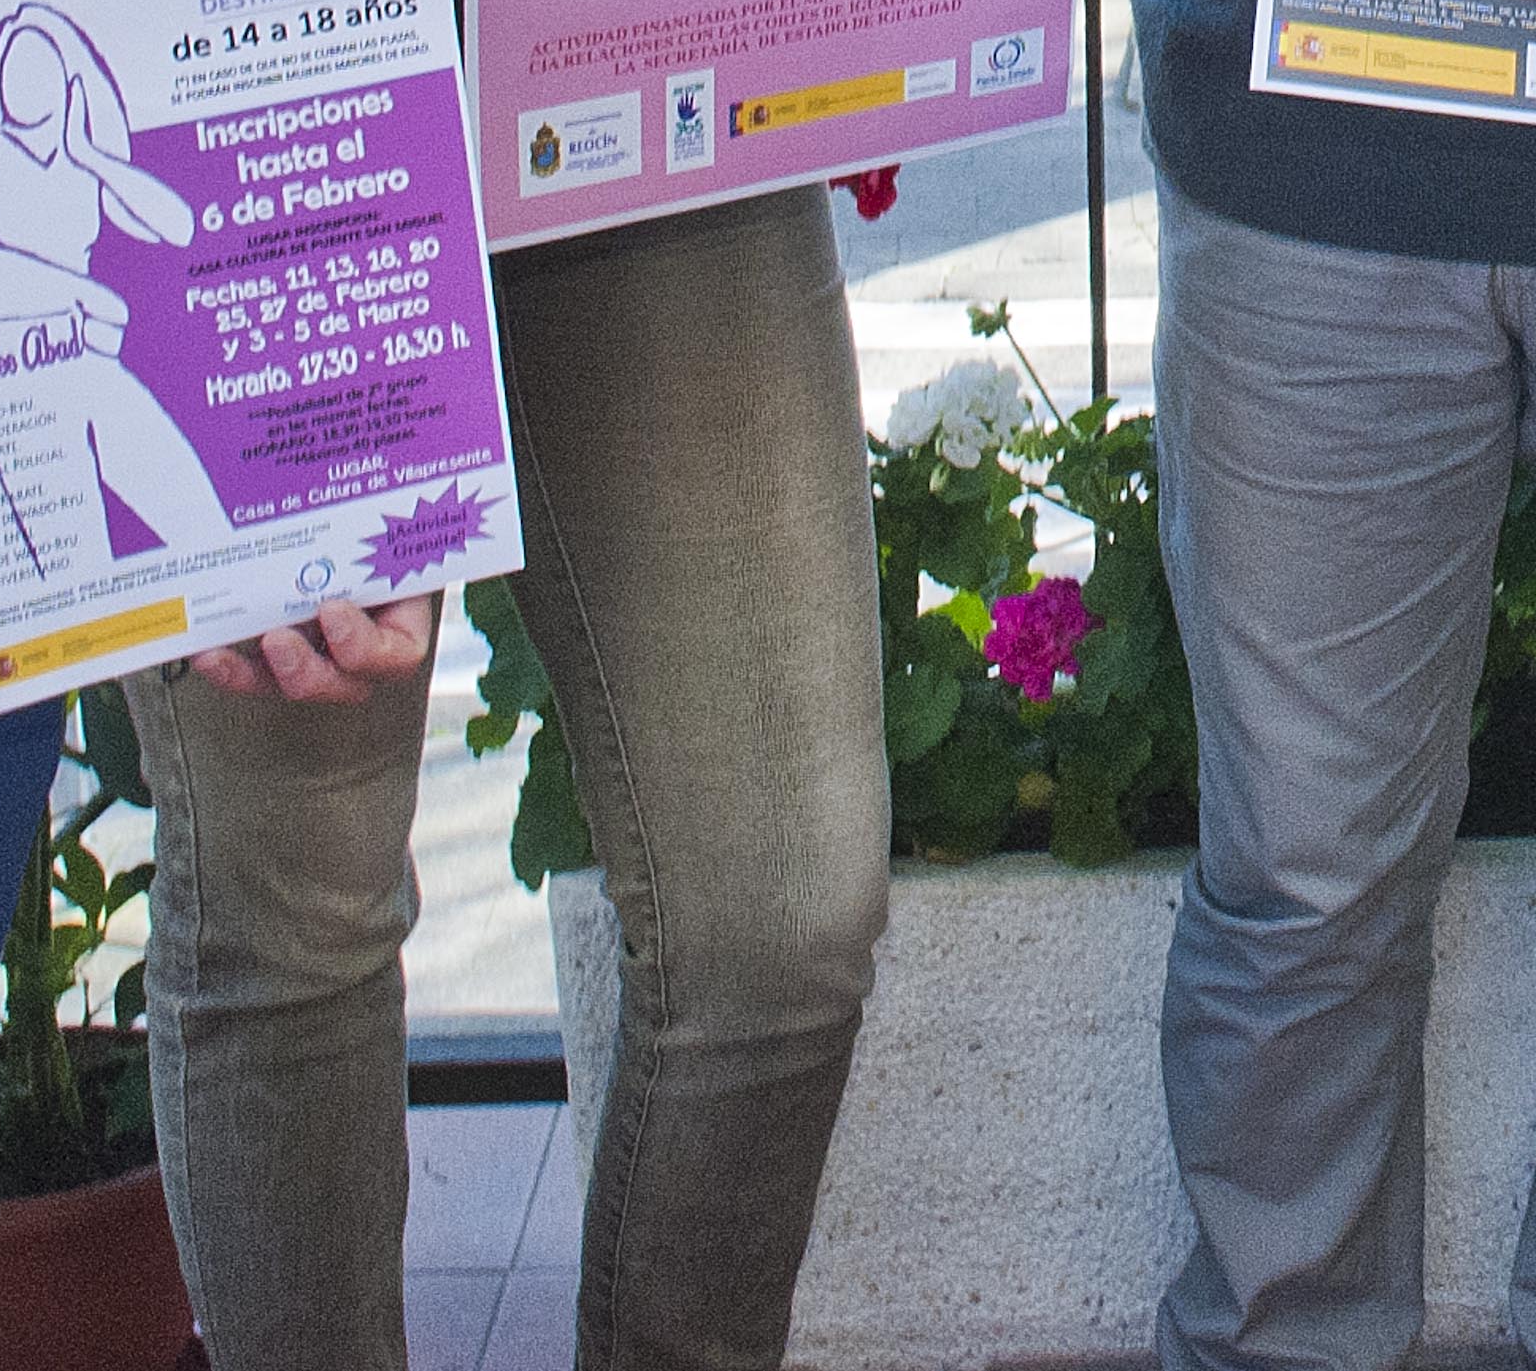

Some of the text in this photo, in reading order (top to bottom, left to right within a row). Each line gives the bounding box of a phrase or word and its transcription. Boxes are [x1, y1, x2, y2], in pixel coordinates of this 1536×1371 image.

[172, 33, 210, 61] de
[223, 22, 259, 51] 14
[271, 22, 287, 41] a
[298, 7, 335, 35] 18
[196, 86, 393, 149] Inscripciones
[237, 128, 365, 183] hasta el
[201, 168, 409, 231] 6 de Febrero
[408, 236, 440, 263] 20
[259, 295, 287, 323] 27
[296, 290, 328, 314] de
[335, 269, 429, 305] Febrero
[221, 296, 429, 362] y 3 5 de Marzo
